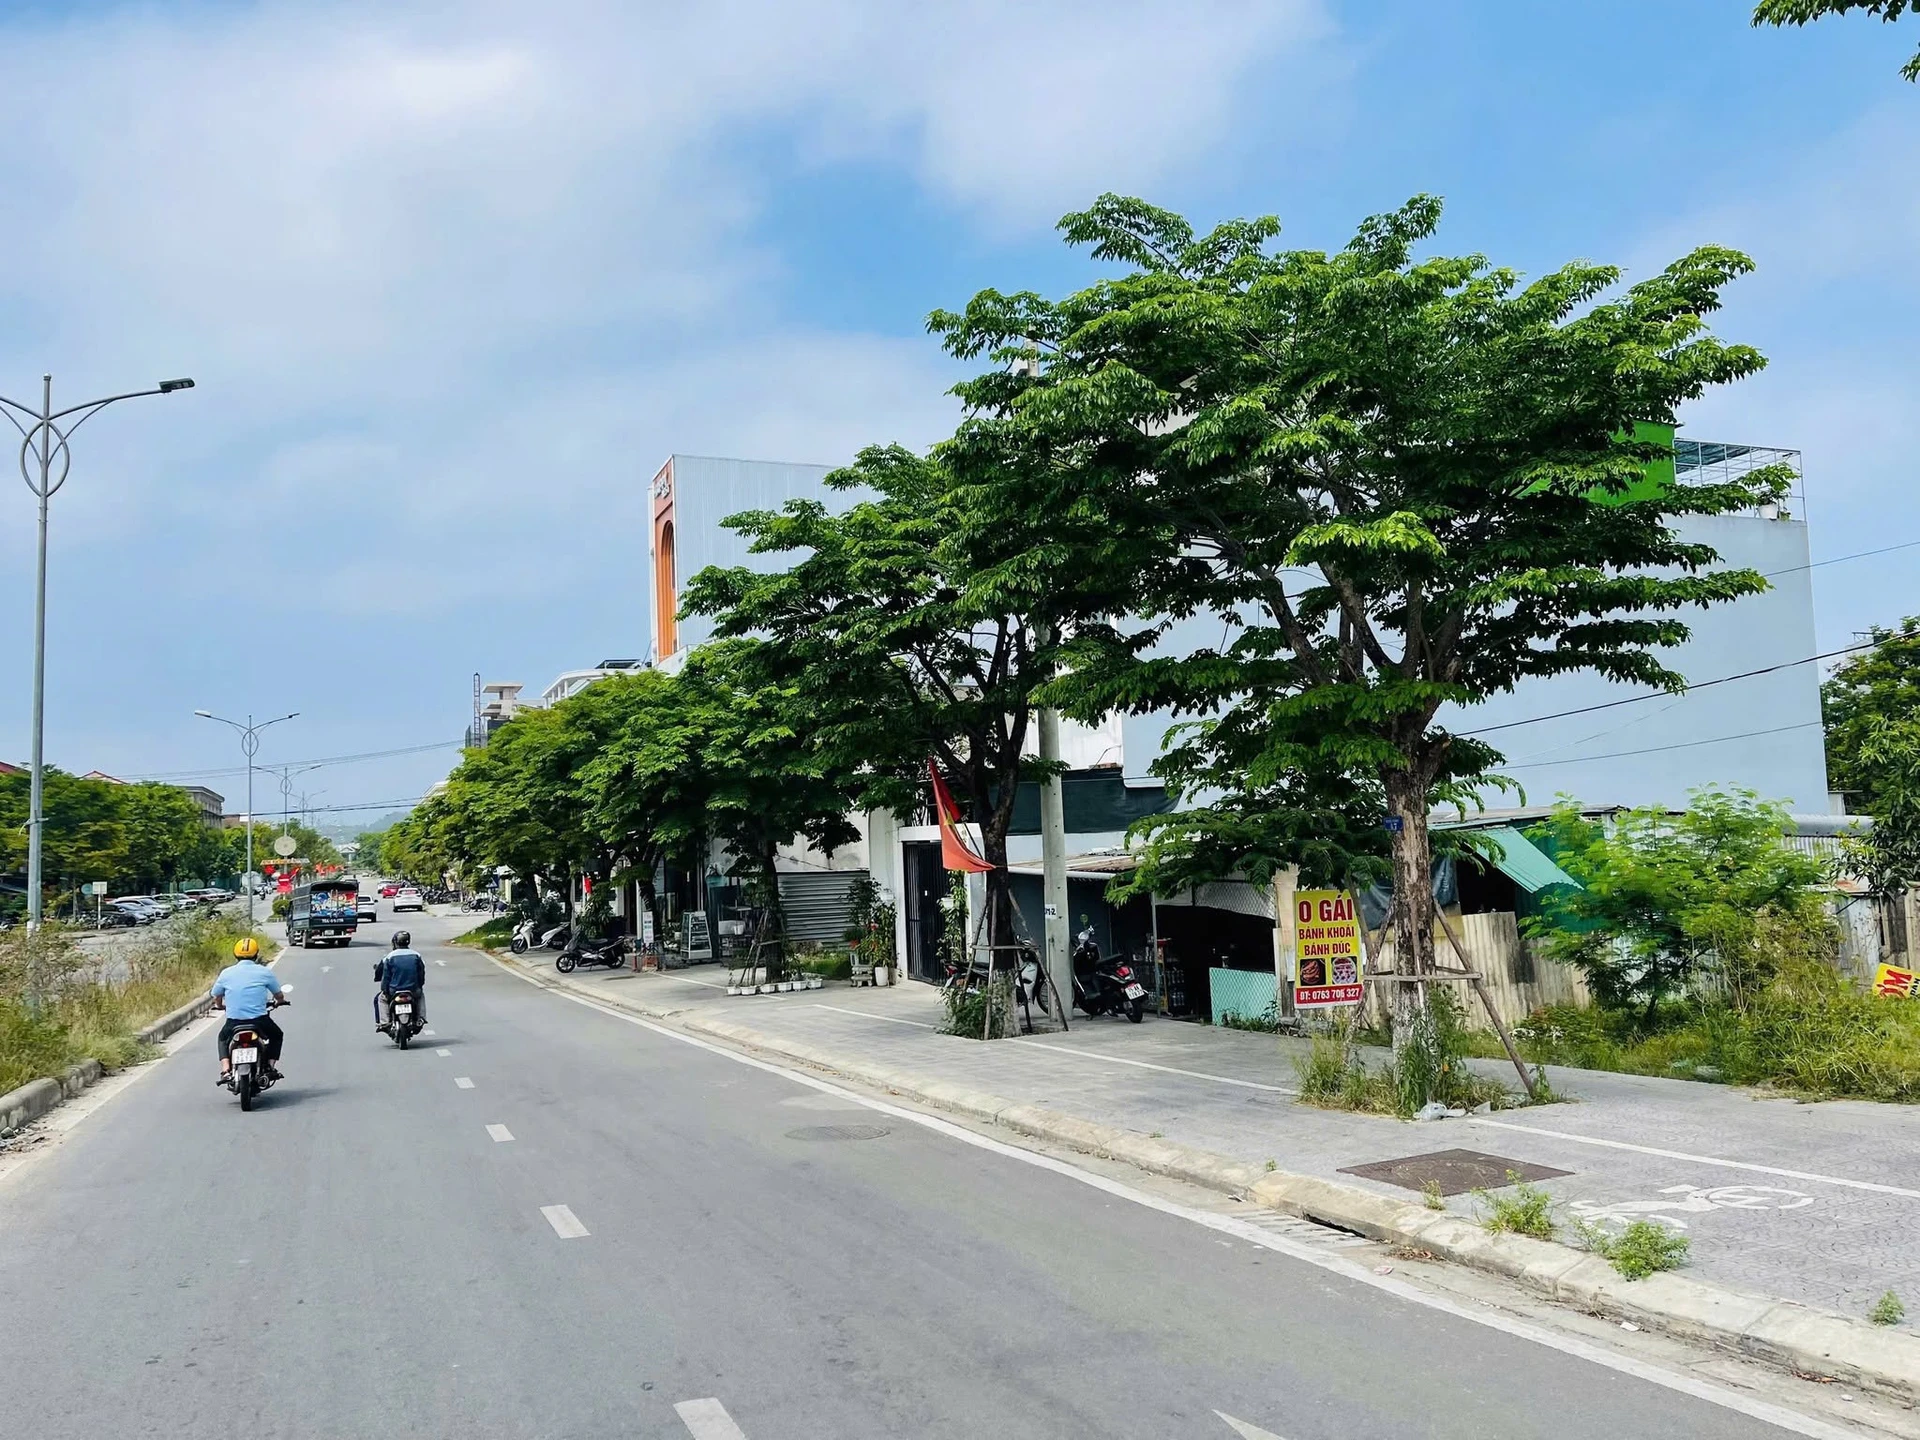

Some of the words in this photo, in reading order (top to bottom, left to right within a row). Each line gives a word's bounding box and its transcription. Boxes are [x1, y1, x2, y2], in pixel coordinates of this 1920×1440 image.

[1299, 901, 1312, 922] O
[1319, 895, 1353, 922] GÁI
[1299, 927, 1325, 940] BÁNH
[1327, 925, 1354, 938] KHOÁI
[1304, 942, 1329, 956] BÁNH
[1332, 940, 1351, 954] ĐÚC
[1312, 990, 1330, 1000] 0763
[1346, 987, 1360, 998] 327
